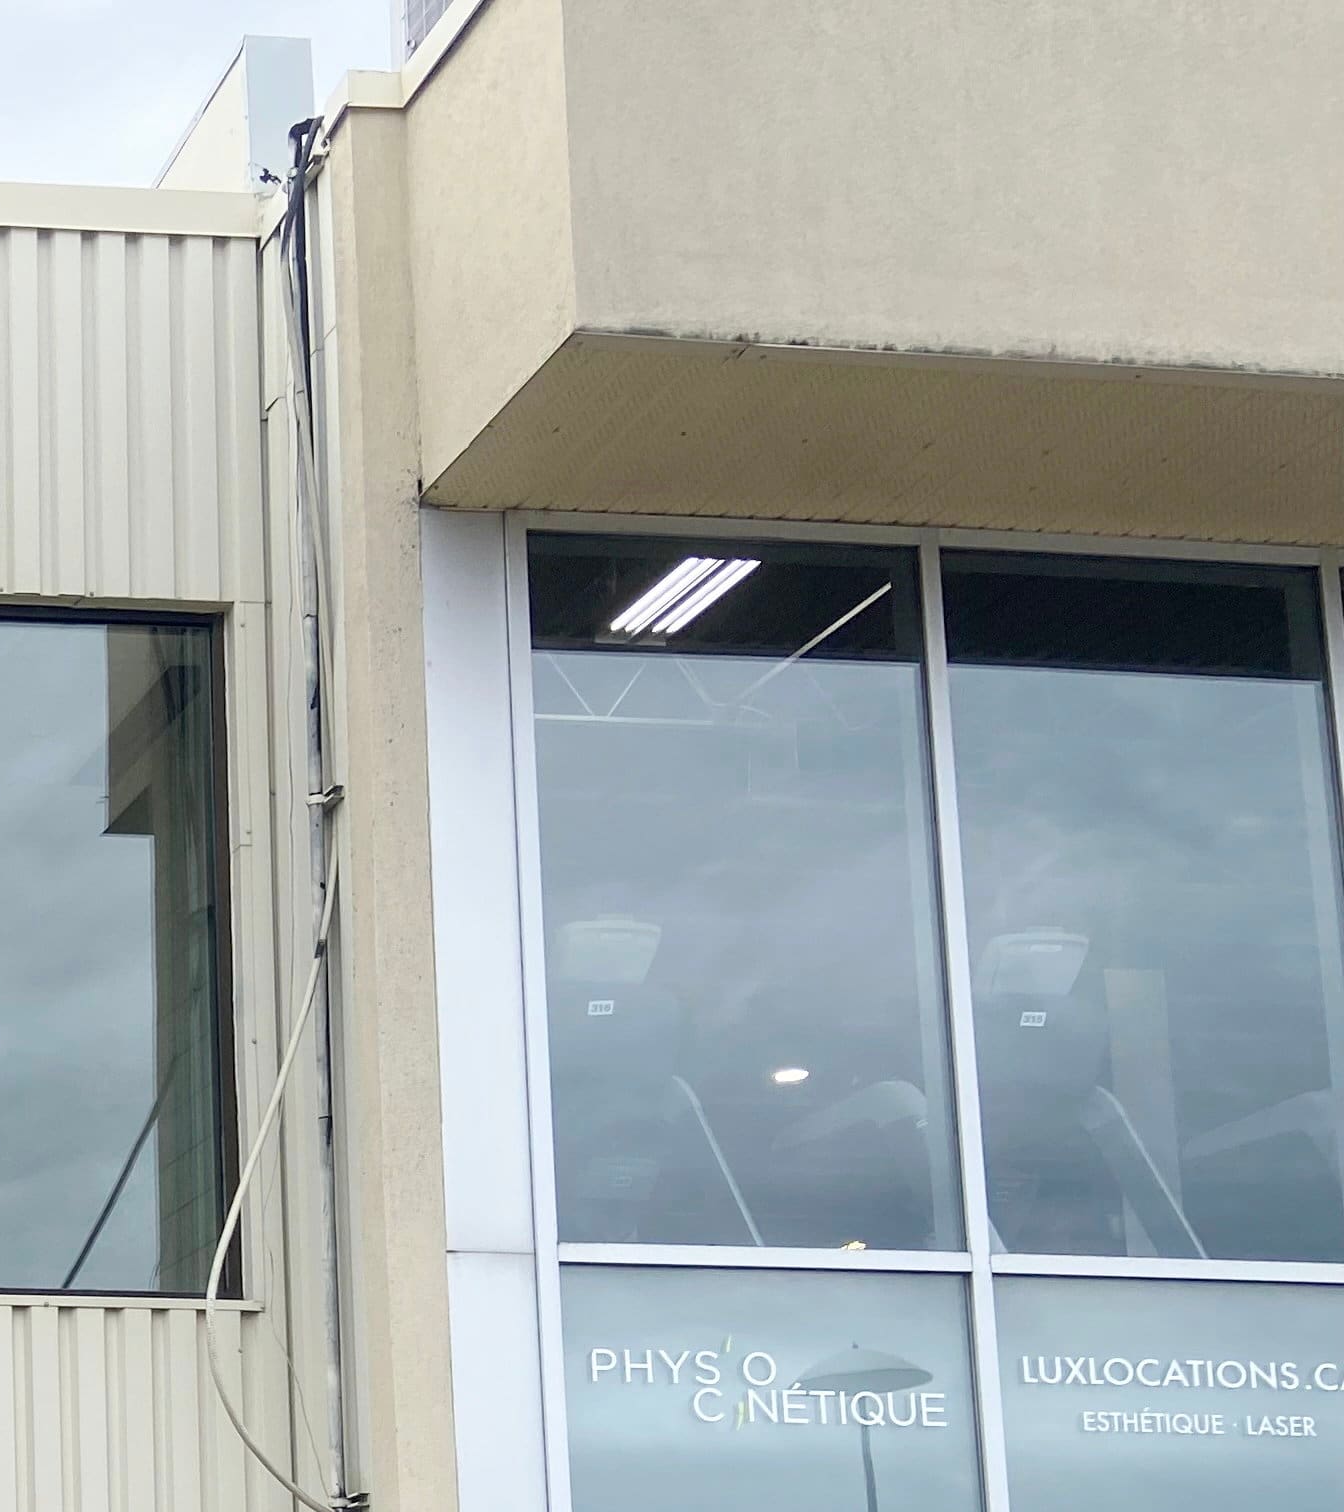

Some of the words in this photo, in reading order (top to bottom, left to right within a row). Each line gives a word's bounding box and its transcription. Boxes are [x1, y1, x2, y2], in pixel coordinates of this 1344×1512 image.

[590, 1336, 778, 1387] PHYSO
[1022, 1355, 1344, 1391] LUXLOCATIONS.C
[1082, 1407, 1225, 1434] ESTHÉTIQUE
[1246, 1415, 1318, 1437] LASER
